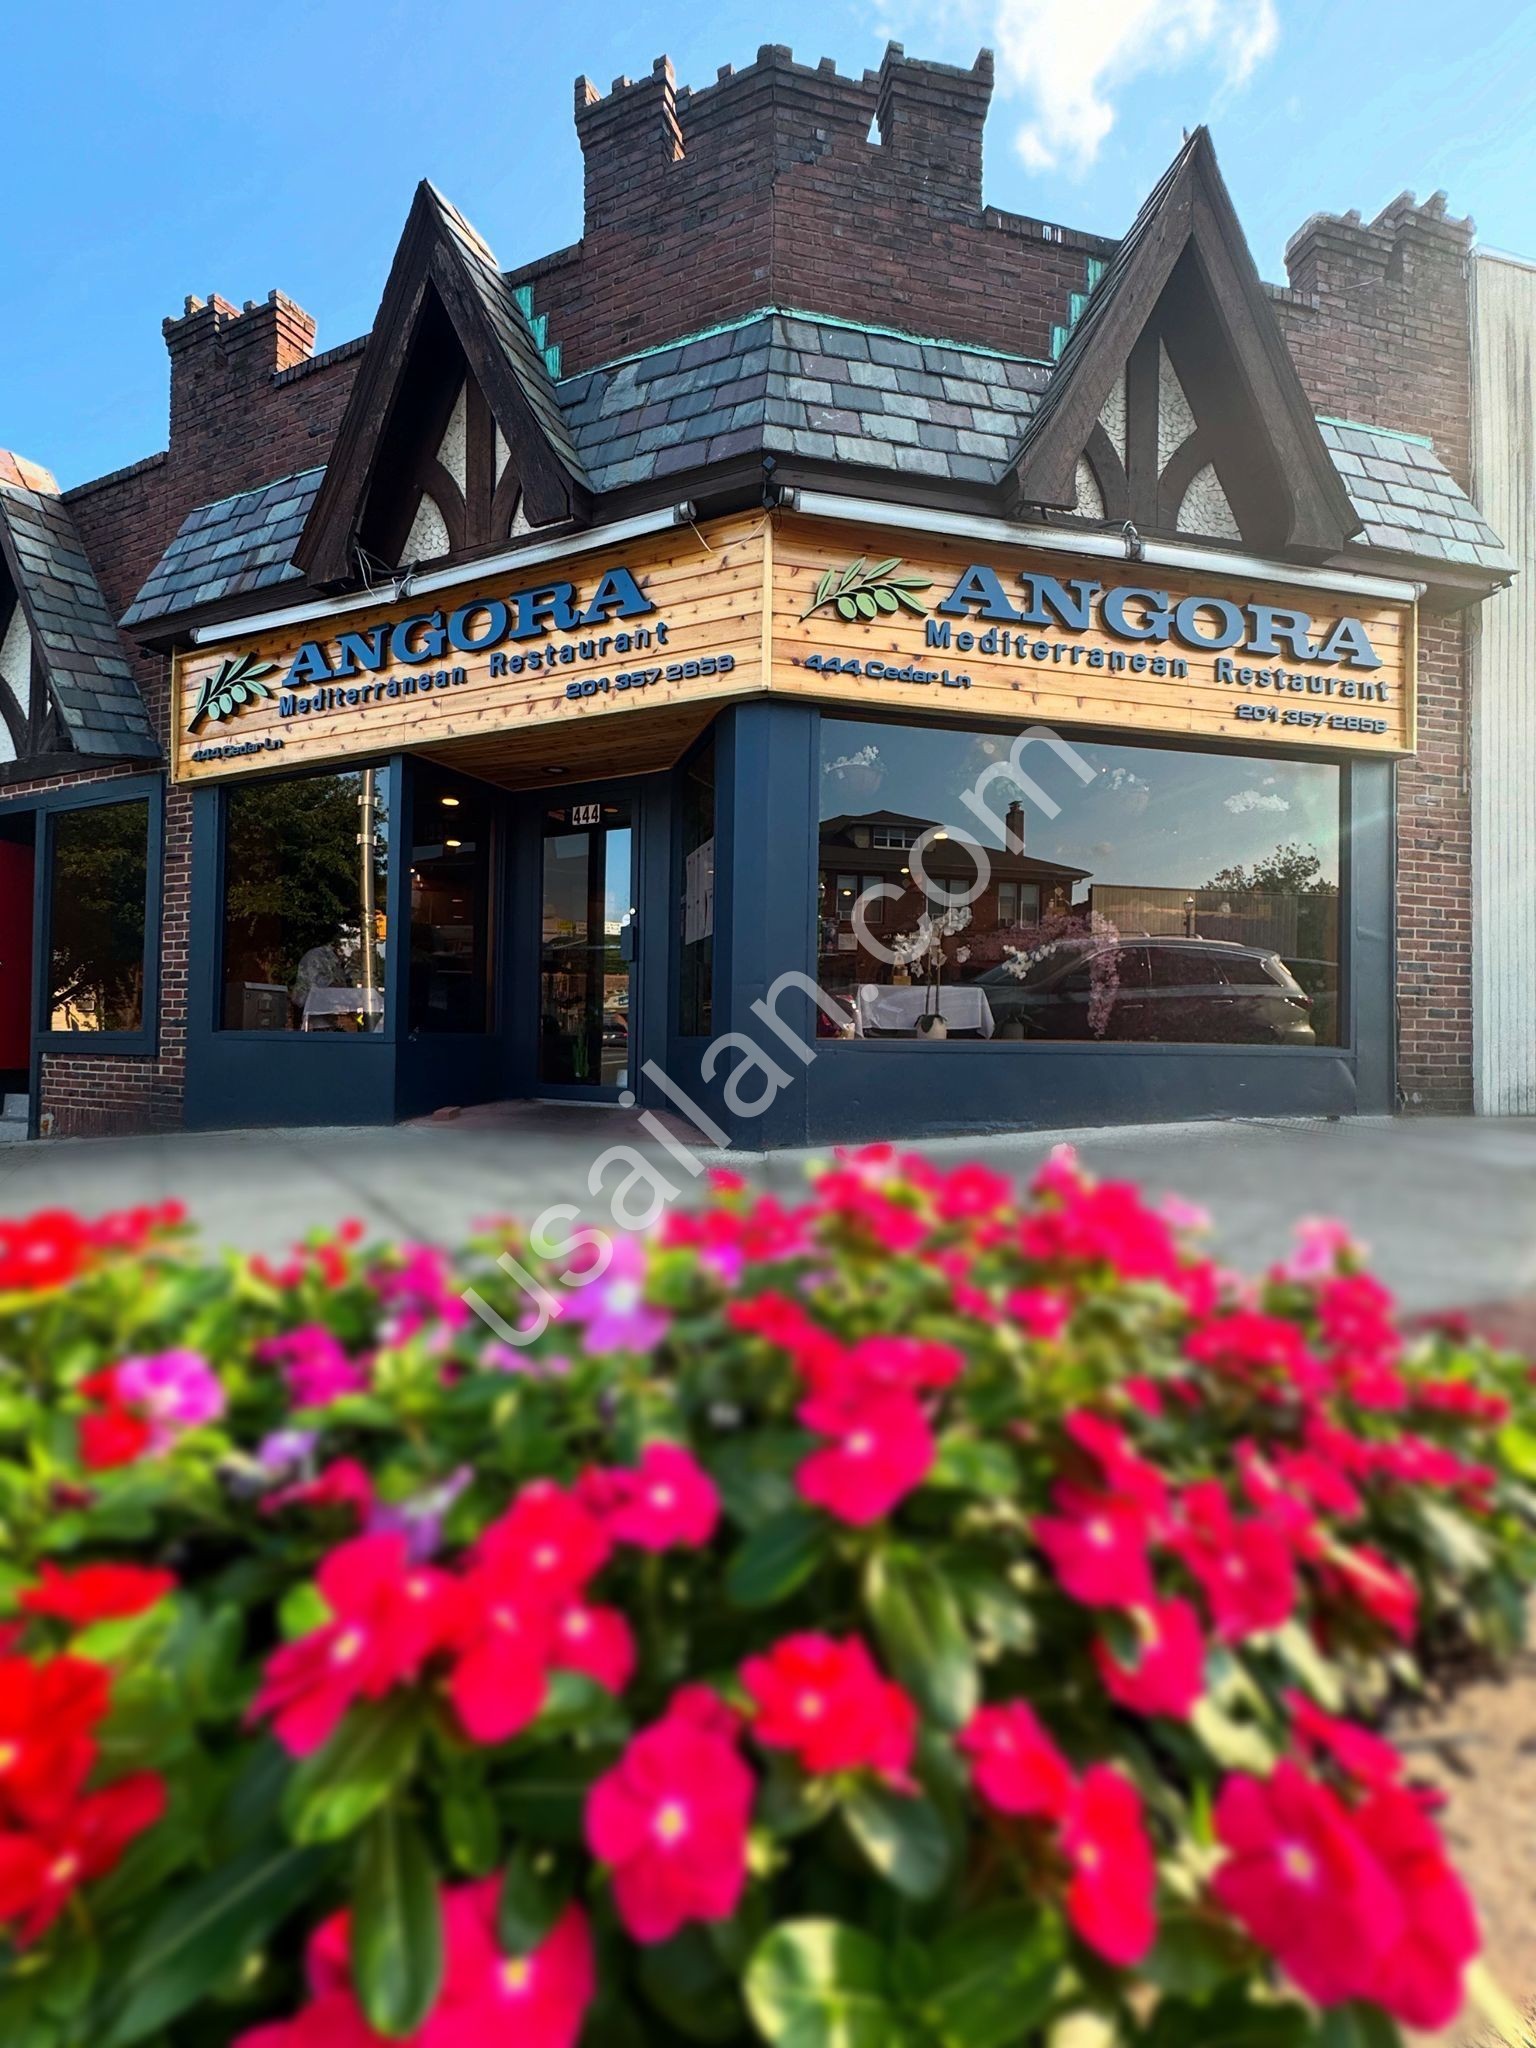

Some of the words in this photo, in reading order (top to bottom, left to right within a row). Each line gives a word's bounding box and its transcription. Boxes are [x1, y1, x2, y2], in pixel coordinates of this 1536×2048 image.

[281, 566, 656, 688] ANGORA
[938, 563, 1383, 670] ANGORA
[279, 665, 468, 718] Mediterranean
[490, 621, 669, 677] Restaurant
[804, 654, 862, 677] 444
[865, 660, 938, 685] Cedar
[942, 669, 971, 689] Ln
[926, 619, 1189, 678] Mediterranean
[1215, 657, 1389, 701] Restaurant
[565, 677, 609, 699] 201
[614, 667, 662, 691] 357
[1236, 703, 1279, 723] 201
[1281, 709, 1327, 727] 357
[1329, 714, 1388, 734] 2858
[191, 747, 222, 762] 444
[221, 741, 265, 758] Cedar
[264, 737, 285, 751] Ln
[573, 805, 599, 824] 444
